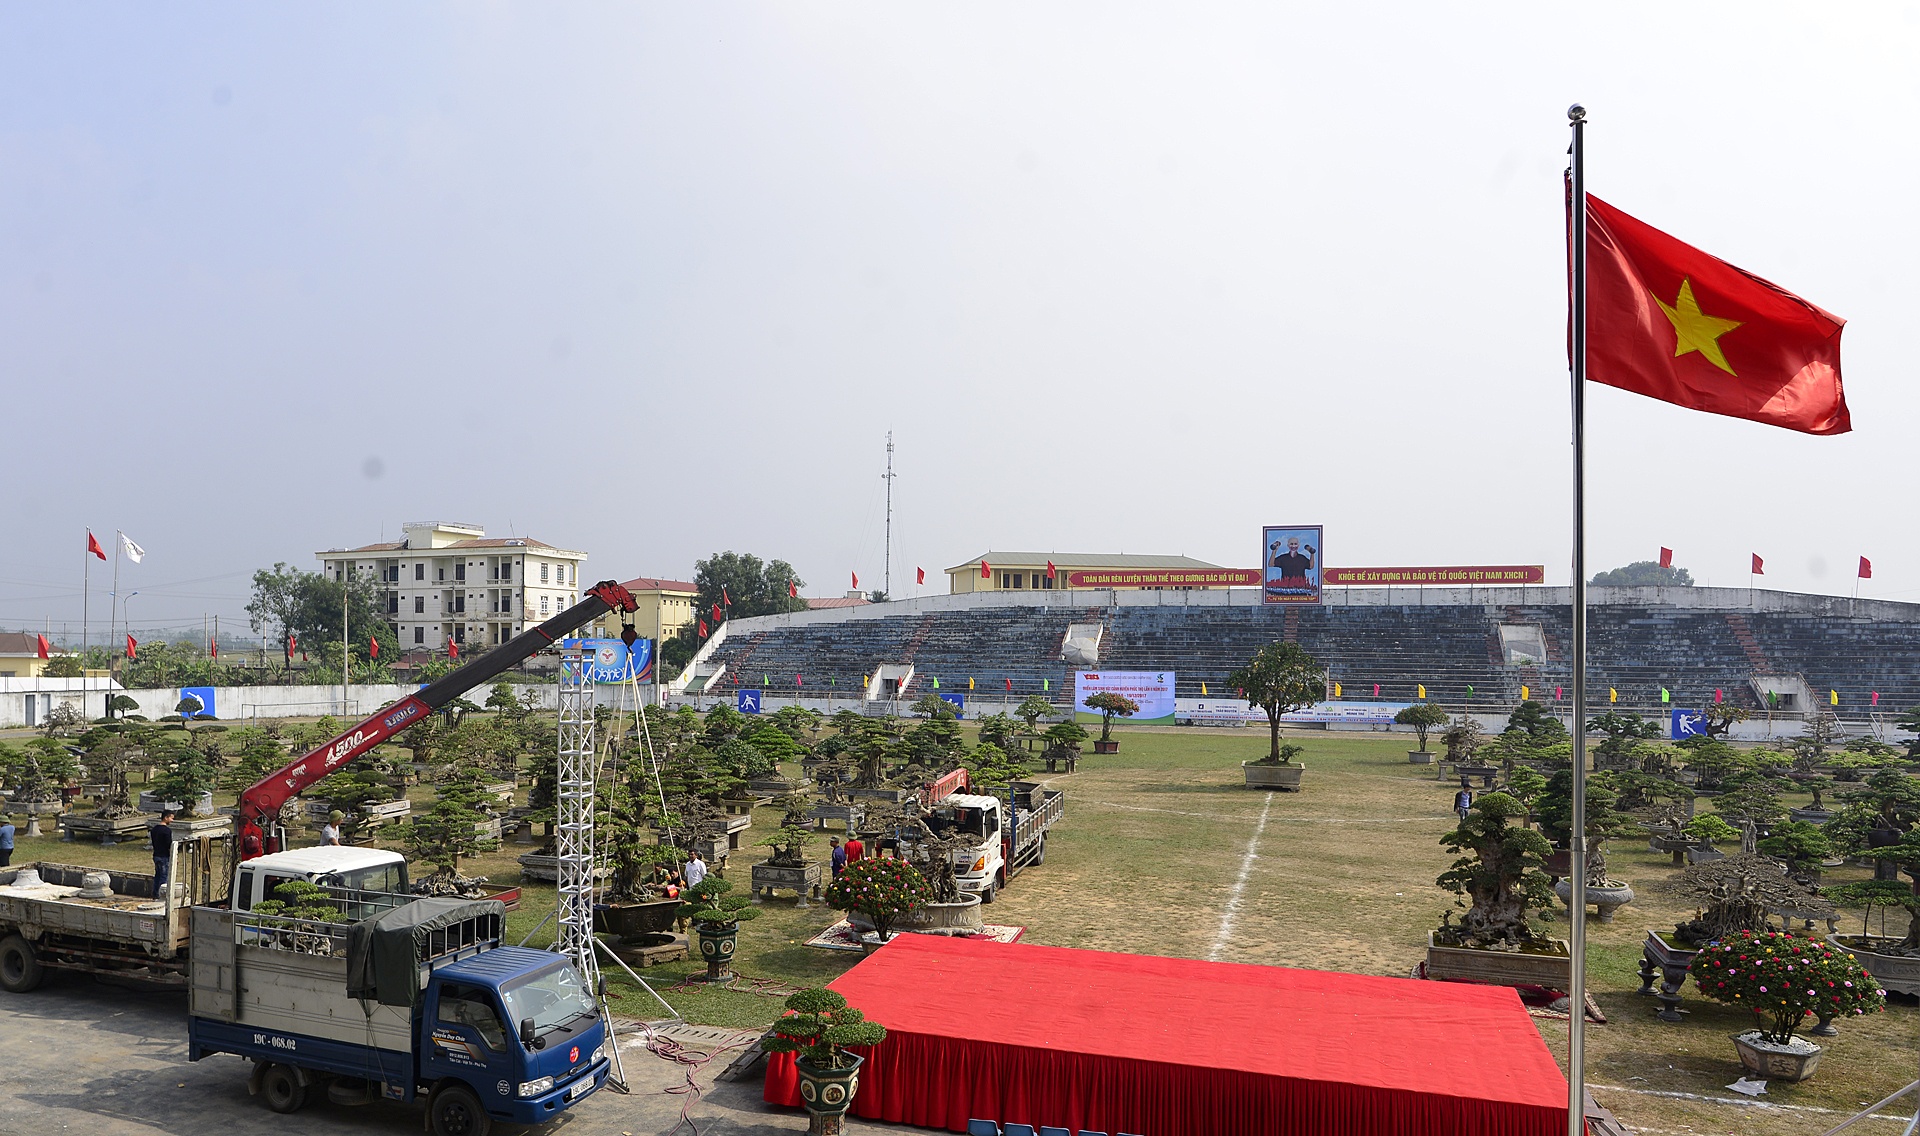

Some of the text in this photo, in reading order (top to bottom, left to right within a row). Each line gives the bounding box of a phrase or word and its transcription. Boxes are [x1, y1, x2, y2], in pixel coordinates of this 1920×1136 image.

[1083, 574, 1097, 583] TOÀN
[1098, 574, 1110, 583] DÂN
[1124, 574, 1141, 584] LUYỆN
[1142, 574, 1157, 582] THÂN
[1170, 574, 1184, 582] THEO
[1186, 574, 1204, 582] GƯƠNG
[1206, 573, 1218, 582] BÁC
[1219, 572, 1227, 582] HỒ
[1235, 574, 1245, 583] ĐẠI
[1338, 570, 1356, 580] KHỎE
[1357, 570, 1366, 580] ĐỂ
[1368, 571, 1380, 580] XÂY
[1382, 572, 1400, 582] DỰNG
[1402, 571, 1411, 580] VÀ
[1413, 569, 1426, 580] BẢO
[1428, 570, 1437, 582] VỆ
[1438, 570, 1447, 580] TỔ
[1448, 570, 1467, 580] QUỐC
[1469, 570, 1484, 581] VIỆT
[1504, 571, 1524, 579] XHCN
[254, 1034, 266, 1045] 19C
[272, 1036, 296, 1050] 068.02
